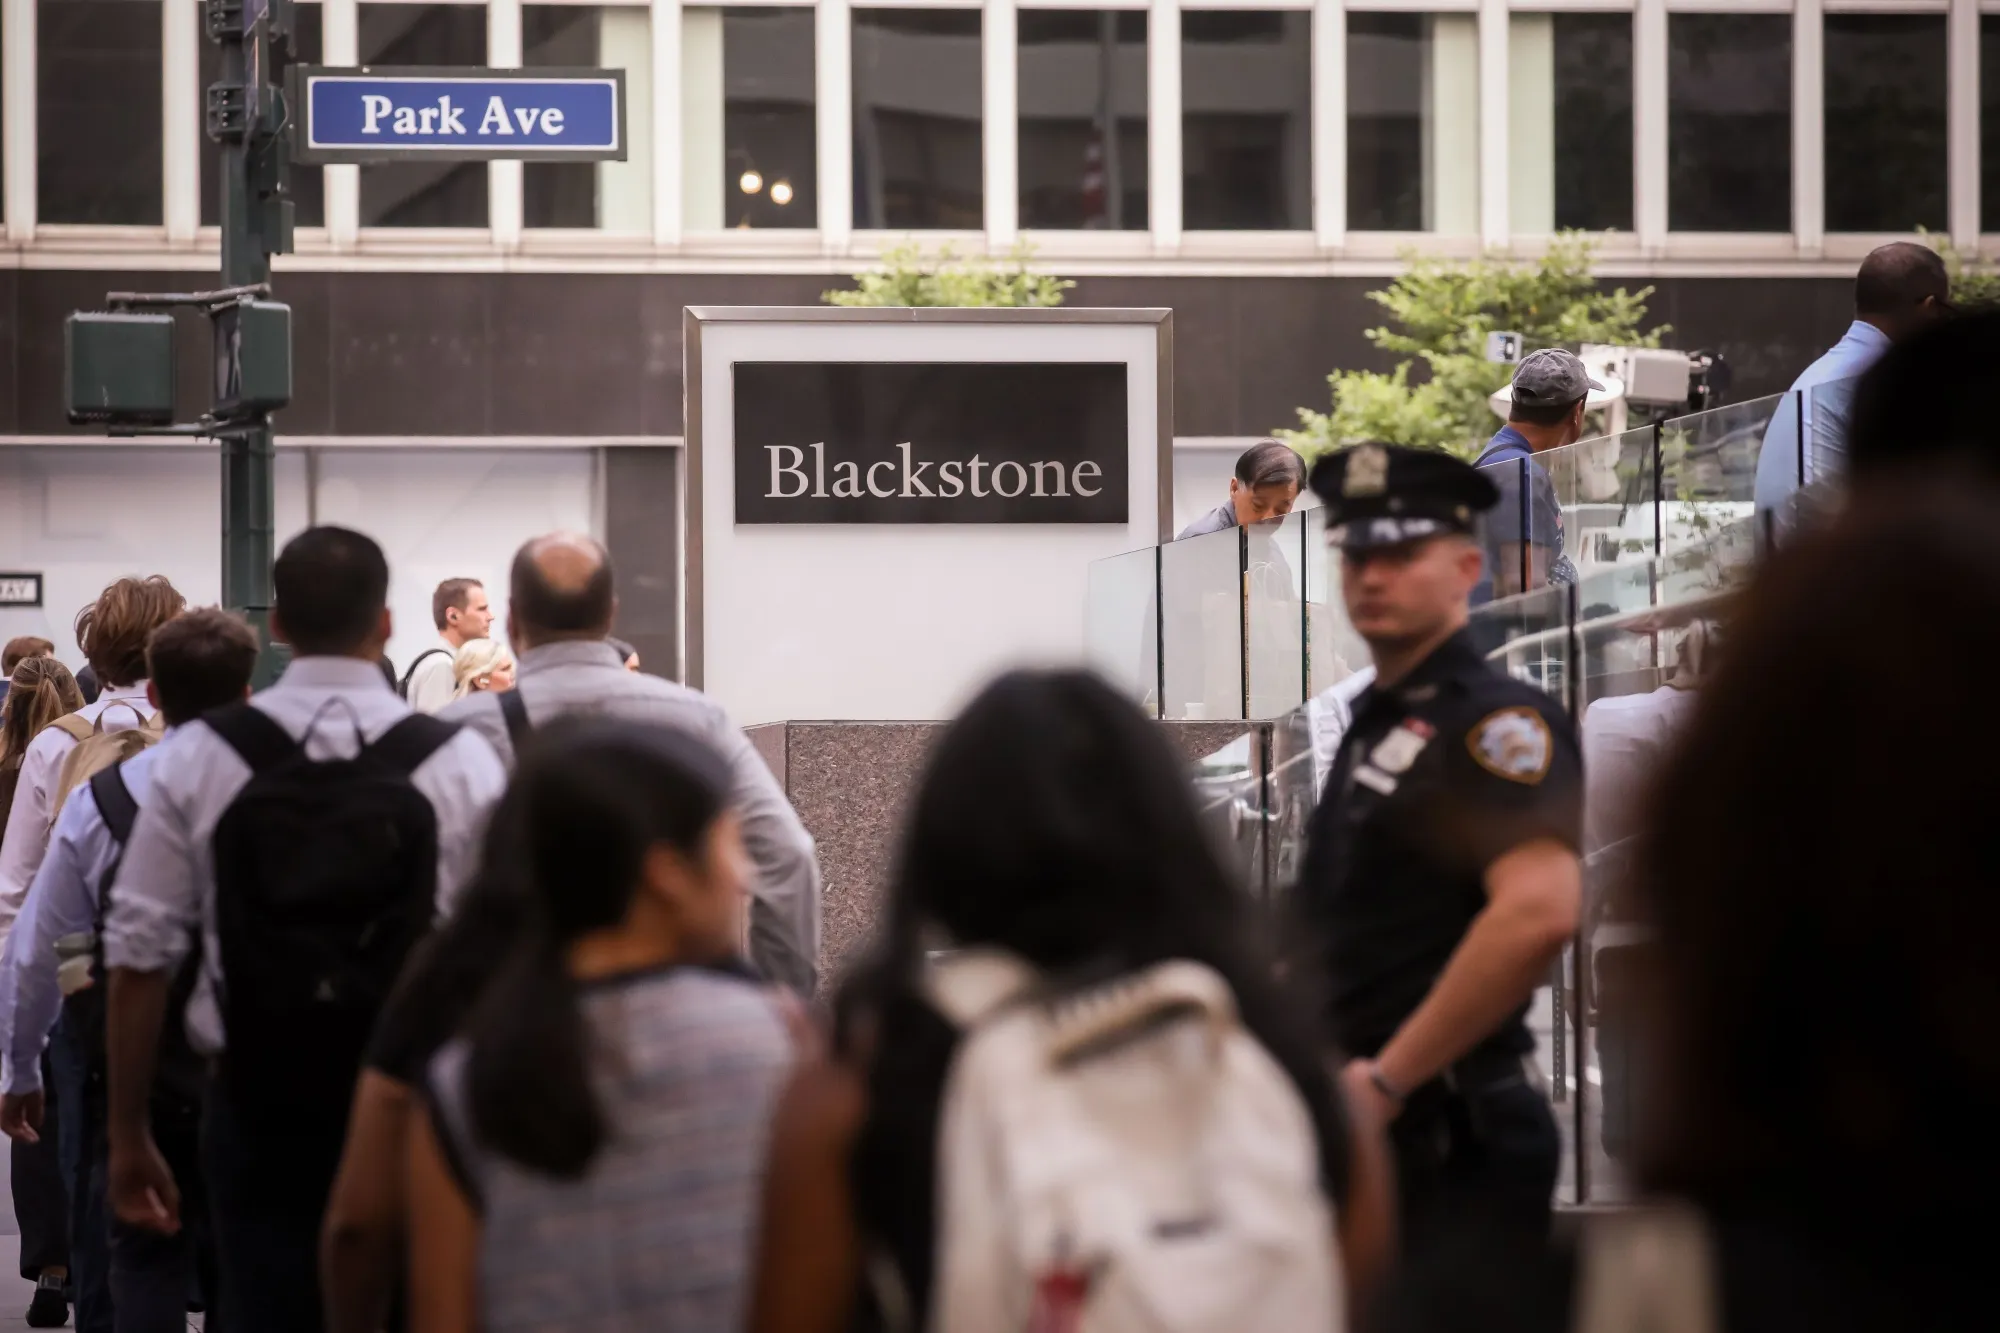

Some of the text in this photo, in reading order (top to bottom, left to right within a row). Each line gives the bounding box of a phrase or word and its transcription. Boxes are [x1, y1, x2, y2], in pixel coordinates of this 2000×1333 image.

[361, 95, 565, 136] Park Ave
[763, 441, 1103, 498] Blackstone
